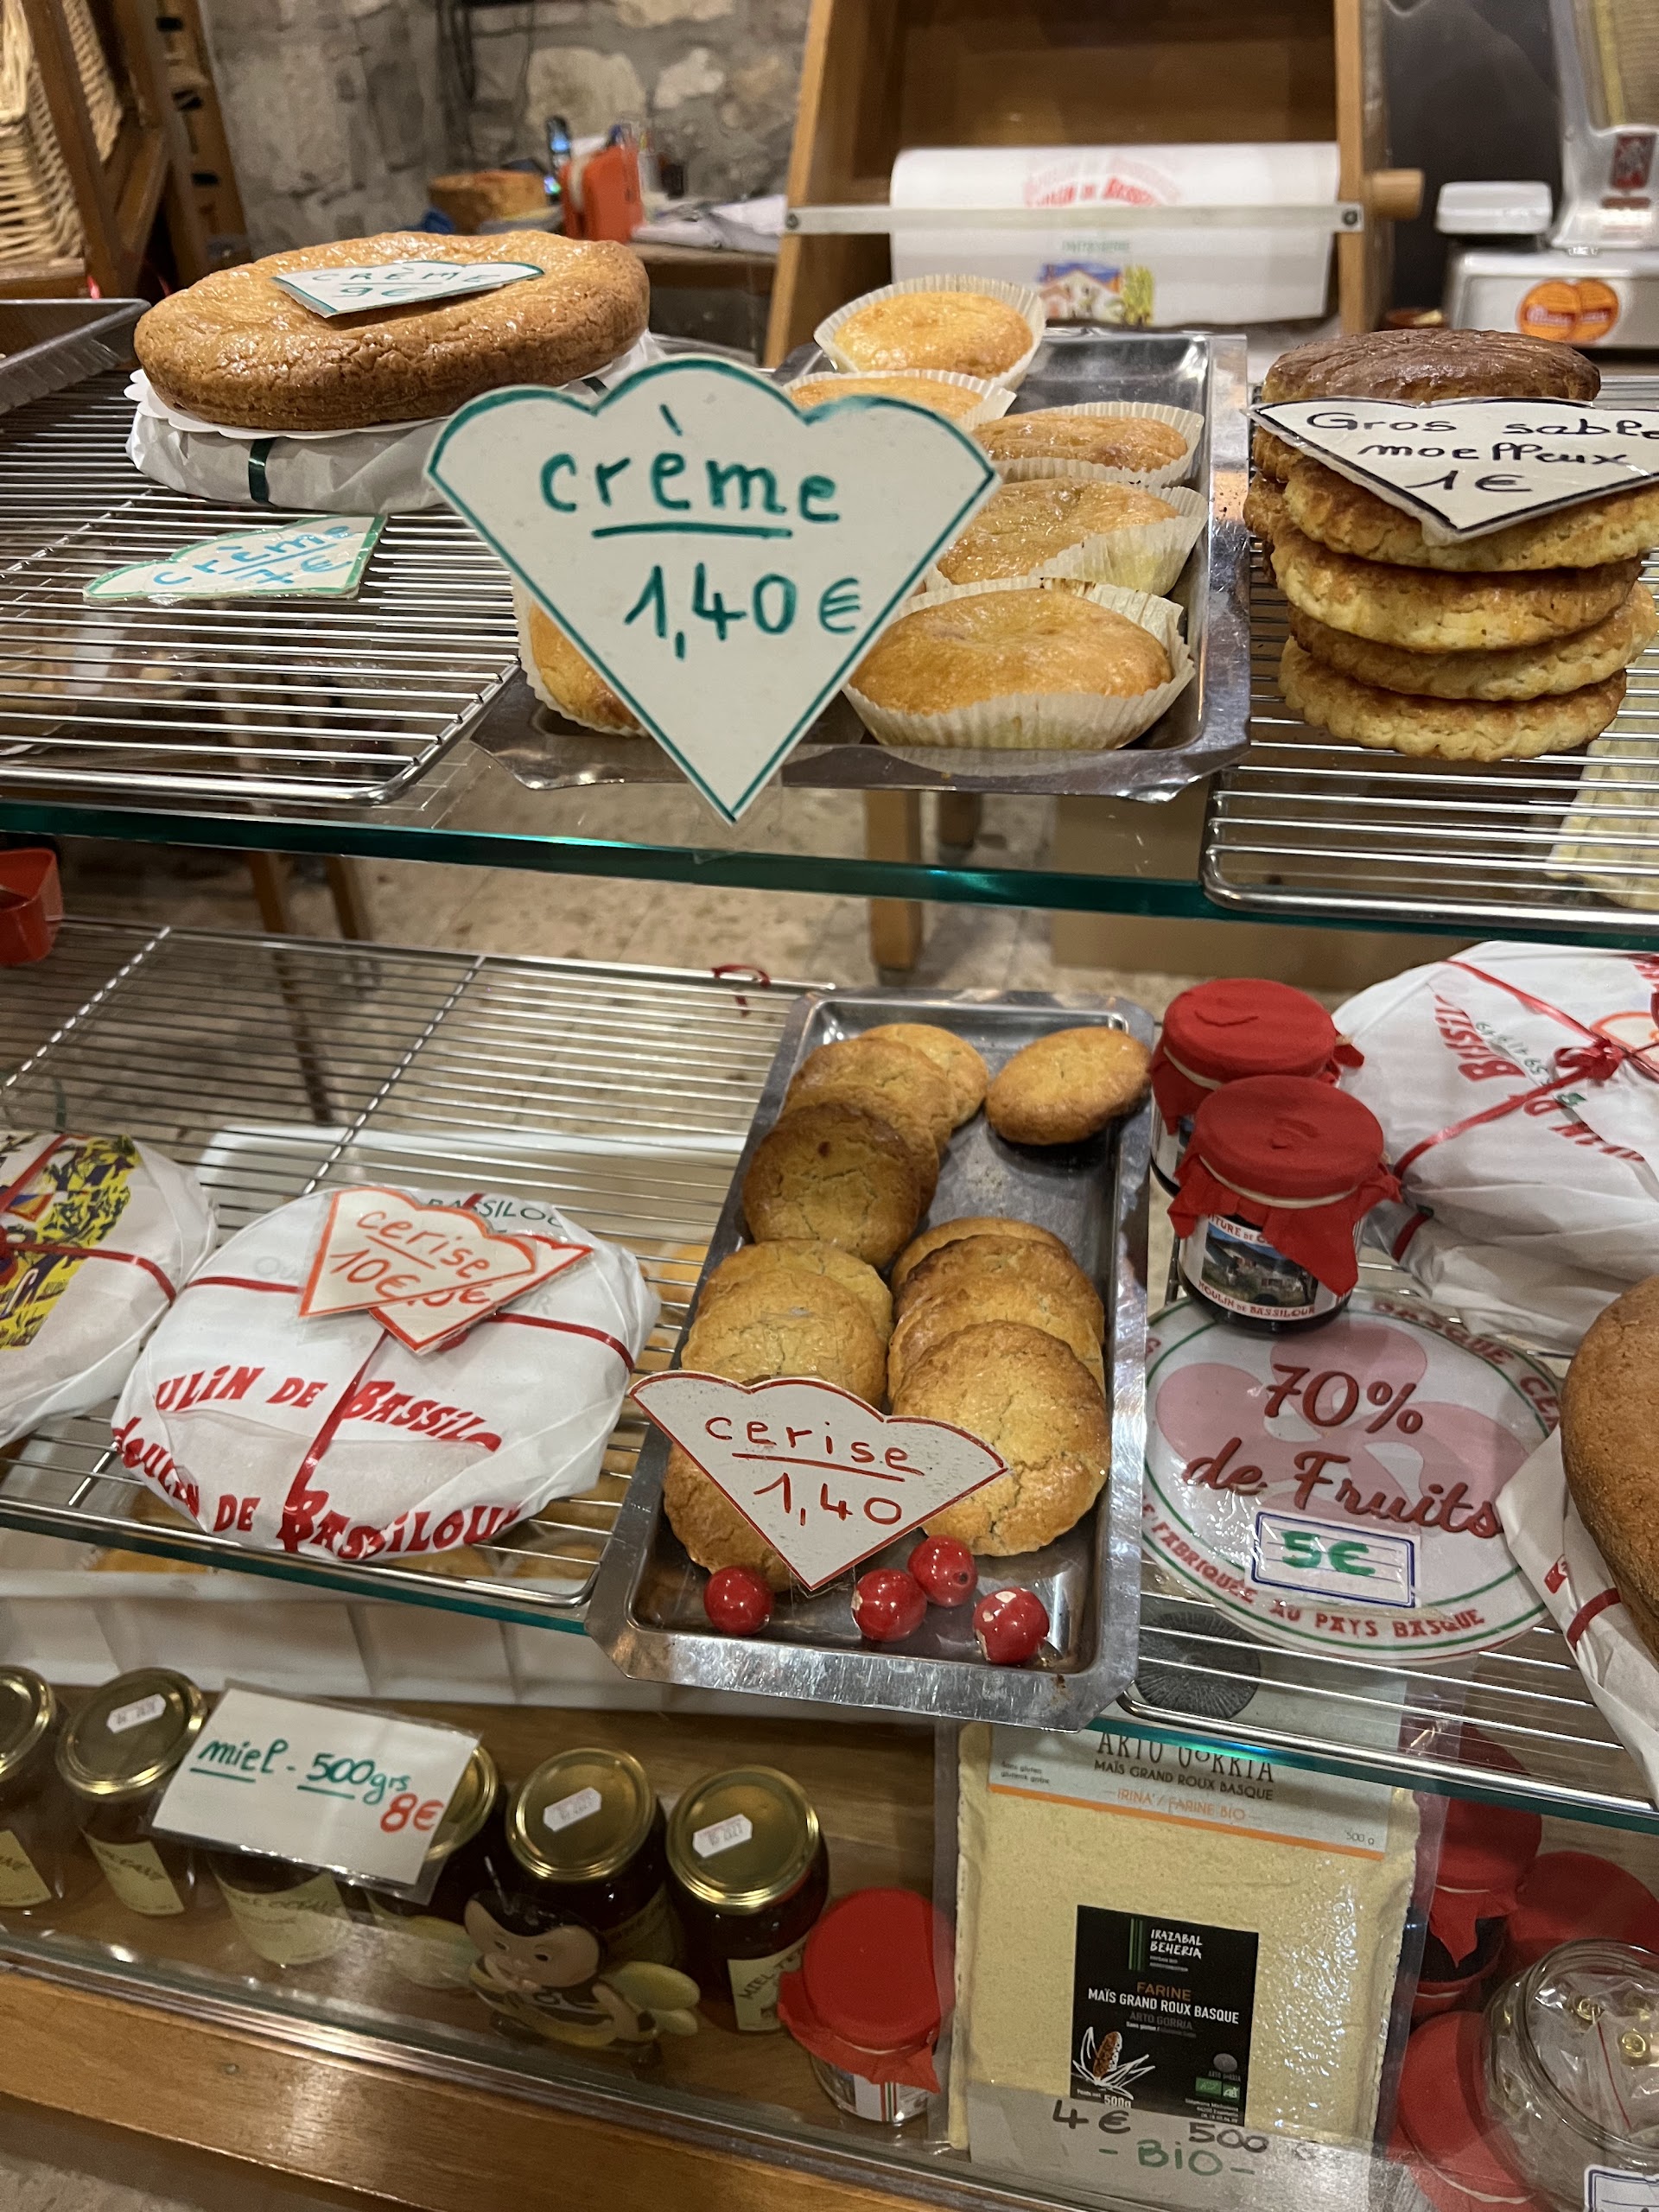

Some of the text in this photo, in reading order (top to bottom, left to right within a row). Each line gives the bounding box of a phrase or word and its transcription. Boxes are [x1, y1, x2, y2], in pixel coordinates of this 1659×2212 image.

[1306, 412, 1457, 432] Gros
[540, 404, 840, 522] crème
[1405, 470, 1533, 493] 1€
[356, 1211, 490, 1278] cerise
[329, 1249, 421, 1300] 10€
[1198, 1279, 1236, 1309] MOULIN
[266, 1376, 329, 1408] DE
[1264, 1363, 1424, 1434] 70%
[705, 1416, 925, 1476] cerise
[753, 1472, 903, 1526] 1,40
[1181, 1436, 1503, 1539] de Fruits
[214, 1494, 261, 1533] DE
[1281, 1530, 1376, 1577] 5€
[1315, 1612, 1380, 1638] PAYS
[1393, 1608, 1485, 1638] BASQUE
[198, 1738, 289, 1773] miel
[306, 1753, 410, 1805] 500grs
[1129, 1765, 1173, 1784] GRAND
[1177, 1776, 1216, 1793] ROUX
[1219, 1782, 1274, 1801] BASQUE
[380, 1793, 444, 1833] 8€
[1088, 1987, 1239, 2024] MAÏS GRAND ROUX BASQUE
[1136, 1981, 1192, 2002] FARINE
[1189, 2121, 1269, 2153] 500
